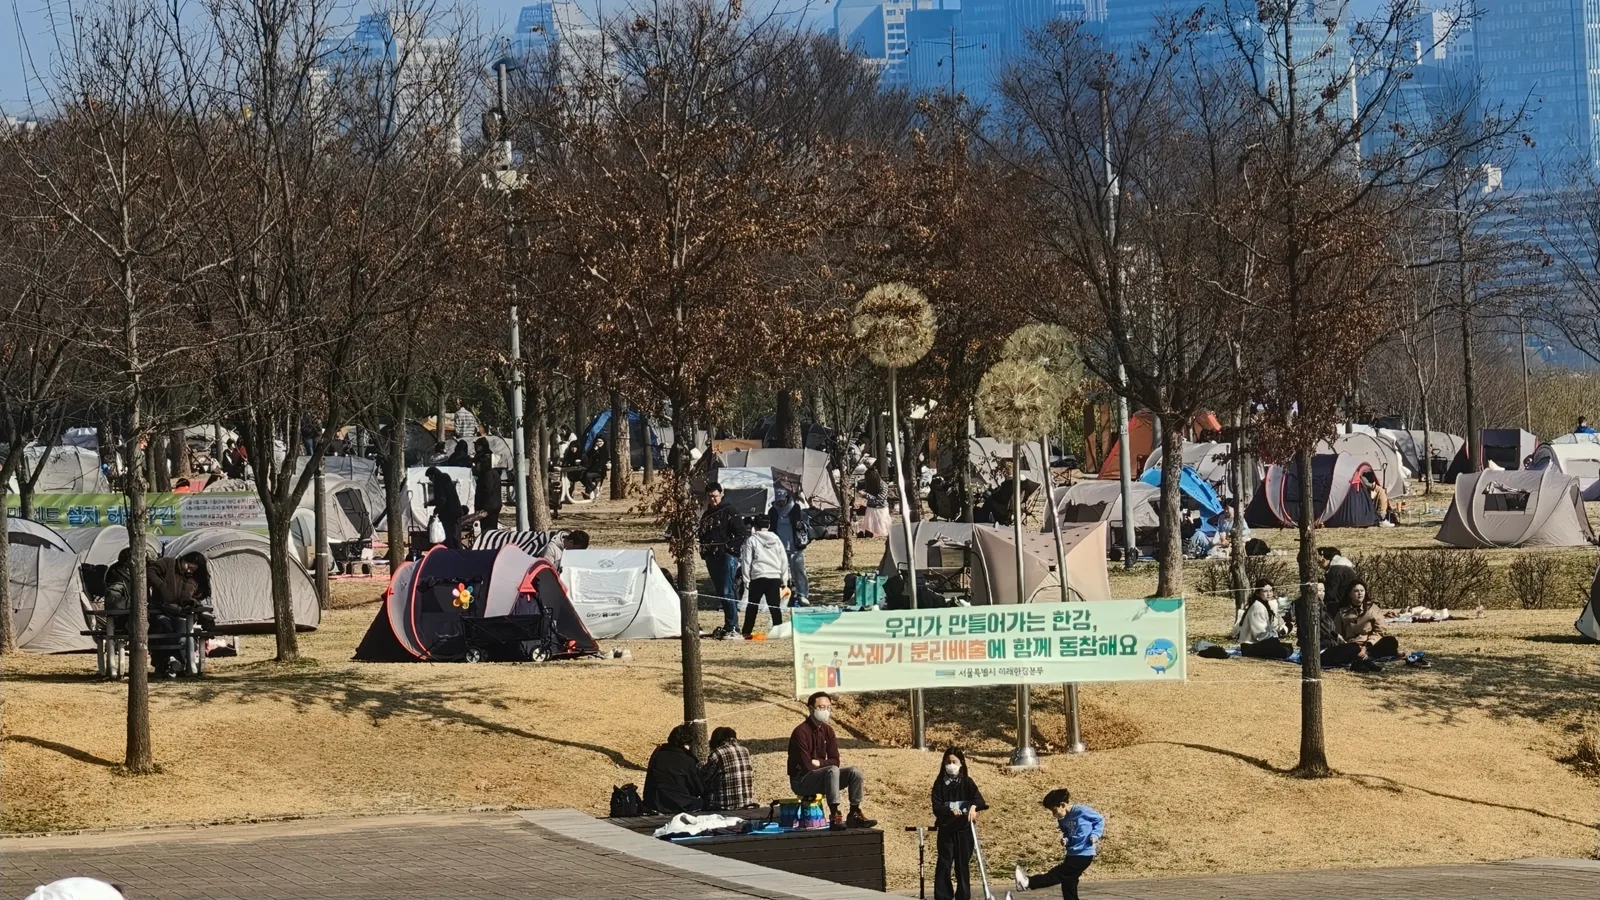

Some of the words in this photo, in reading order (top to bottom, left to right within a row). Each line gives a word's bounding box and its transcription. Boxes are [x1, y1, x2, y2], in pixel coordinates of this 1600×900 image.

[67, 505, 100, 526] 설치
[886, 615, 942, 638] 우리가
[949, 611, 1045, 635] 만들어가는
[1053, 609, 1097, 633] 한강,
[847, 643, 903, 666] 쓰레기
[910, 638, 1006, 663] 분리배출에
[1013, 637, 1052, 659] 함께
[1059, 634, 1138, 657] 동참해요
[958, 667, 996, 678] 서울특별시
